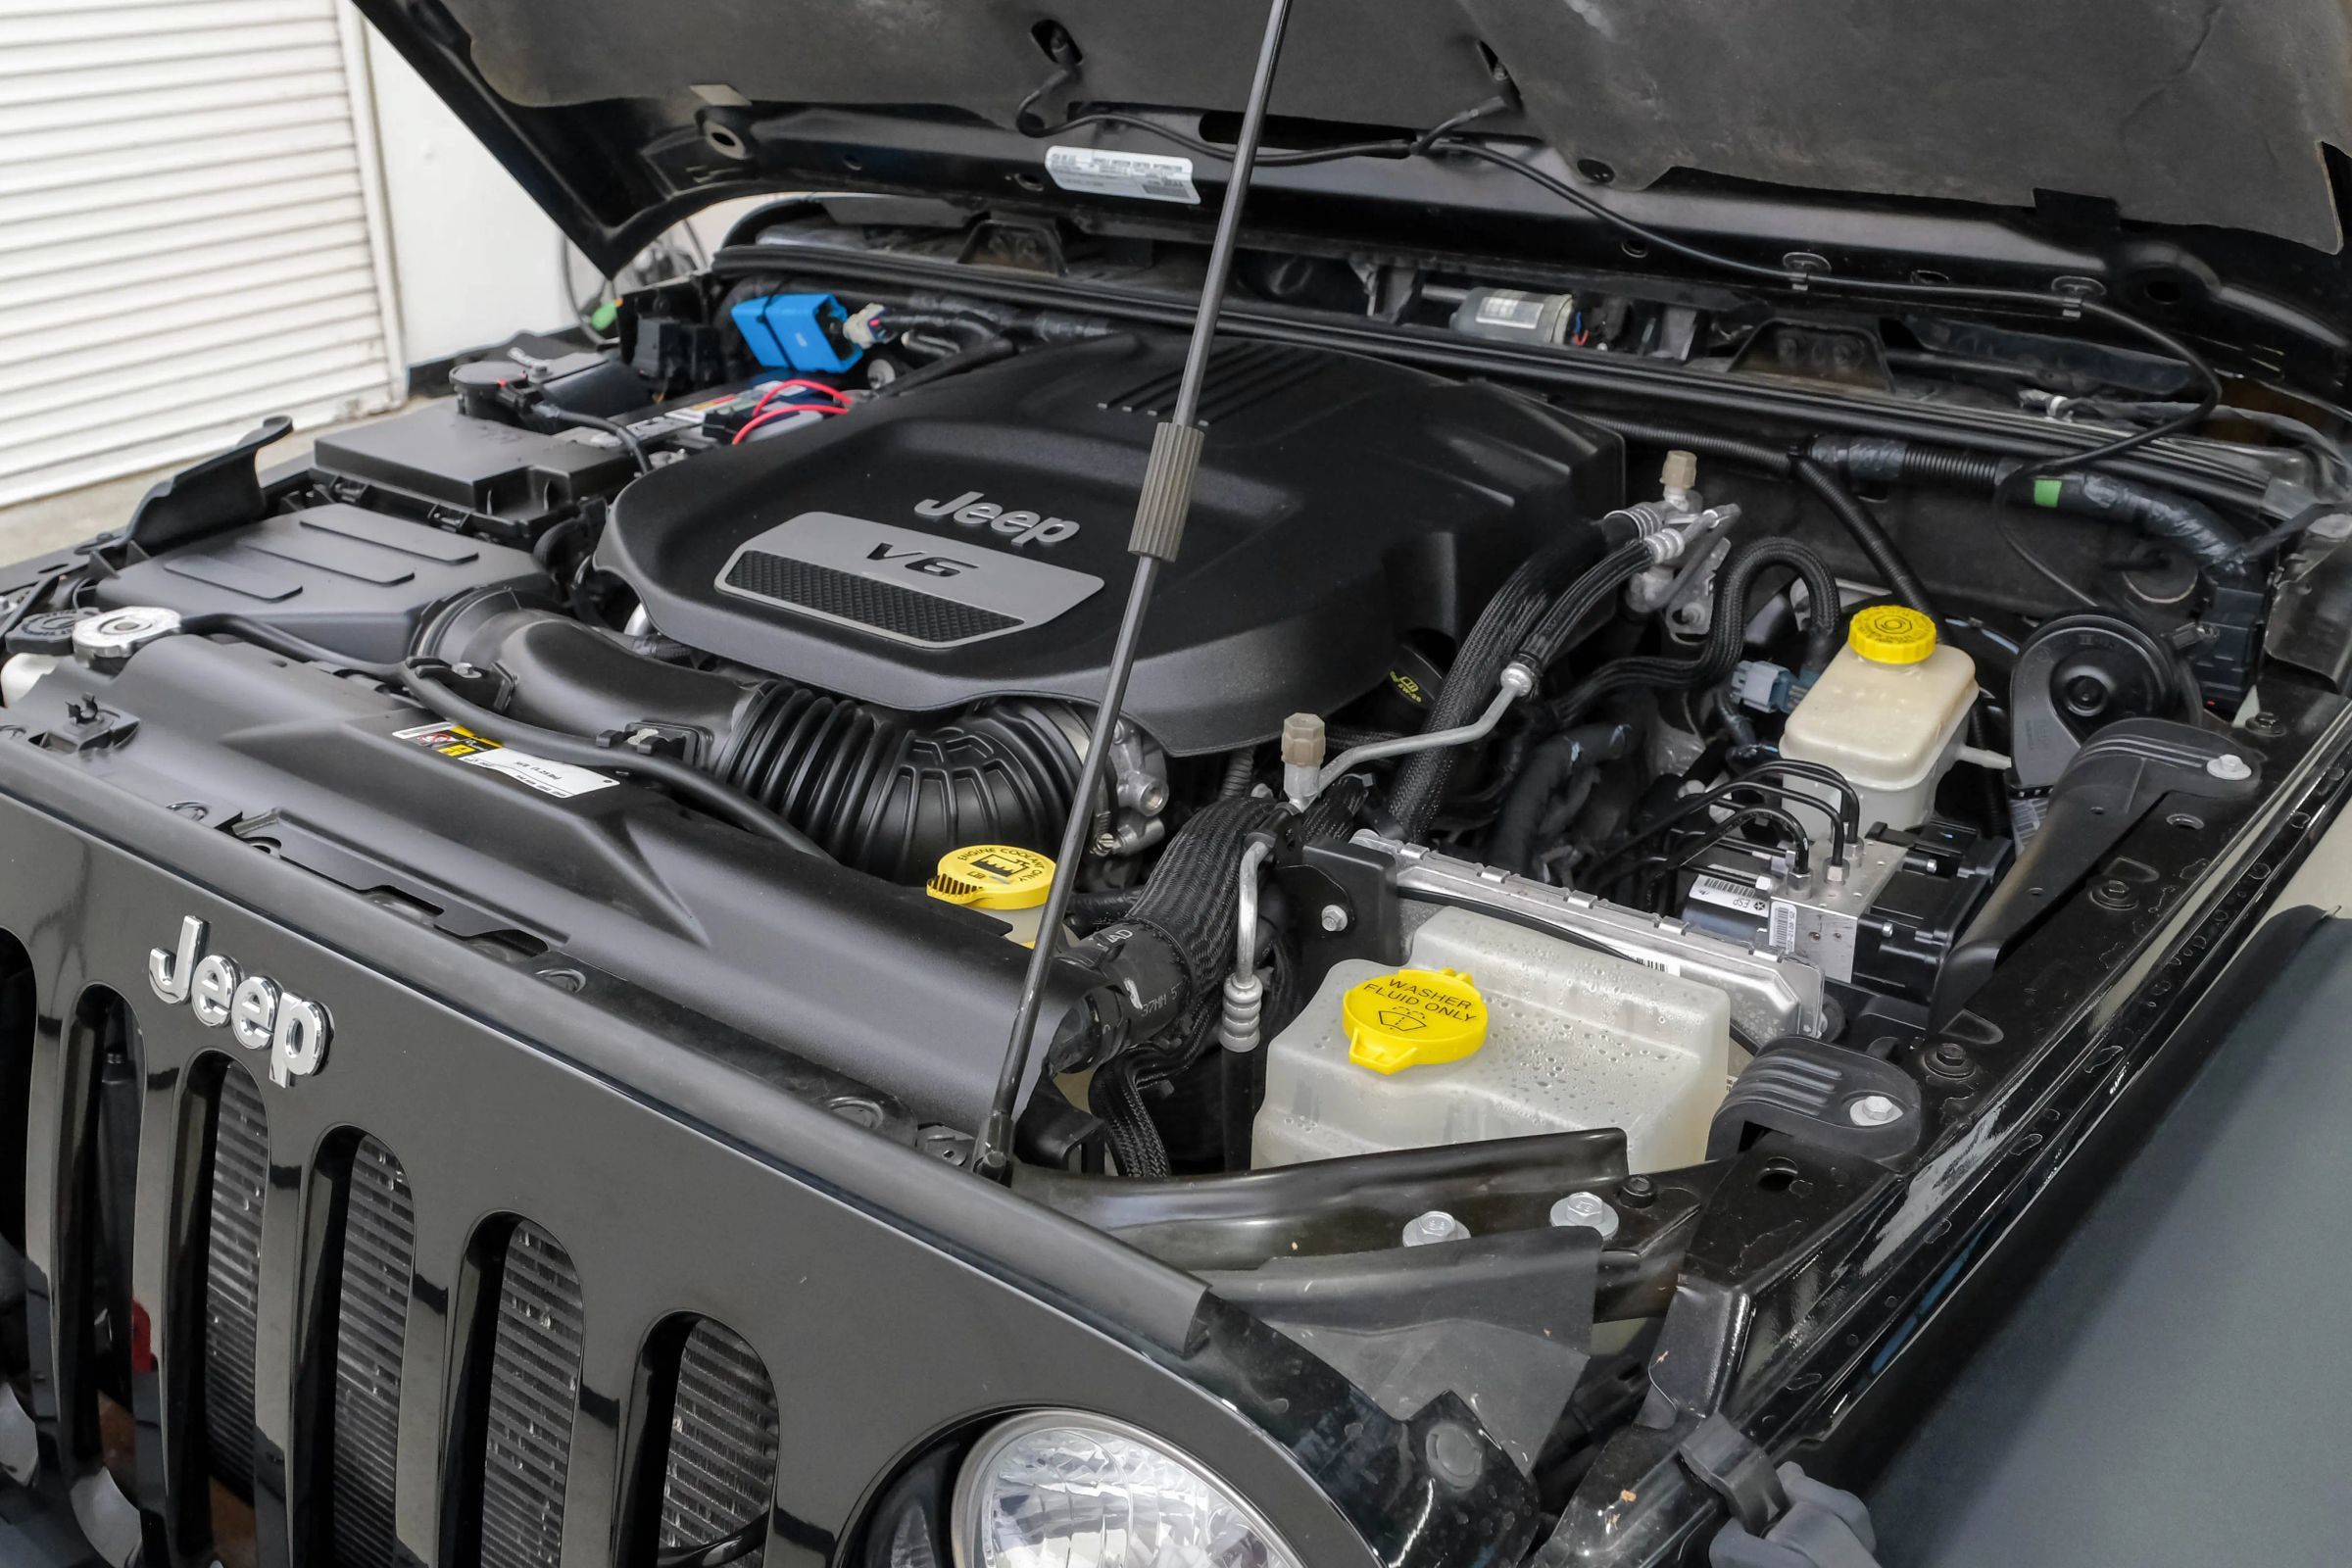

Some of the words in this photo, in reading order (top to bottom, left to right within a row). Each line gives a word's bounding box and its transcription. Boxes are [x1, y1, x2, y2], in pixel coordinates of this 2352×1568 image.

[913, 491, 1080, 547] Jeep
[866, 542, 980, 577] V6
[956, 848, 996, 860] ENGINE
[1000, 848, 1045, 869] COOLANT
[1018, 869, 1043, 882] ONLY
[1732, 897, 1750, 908] ESP
[149, 914, 334, 1089] Jeep
[1363, 983, 1420, 1005] FLUID
[1424, 1002, 1477, 1022] ONLY
[1389, 978, 1472, 1009] WASHER
